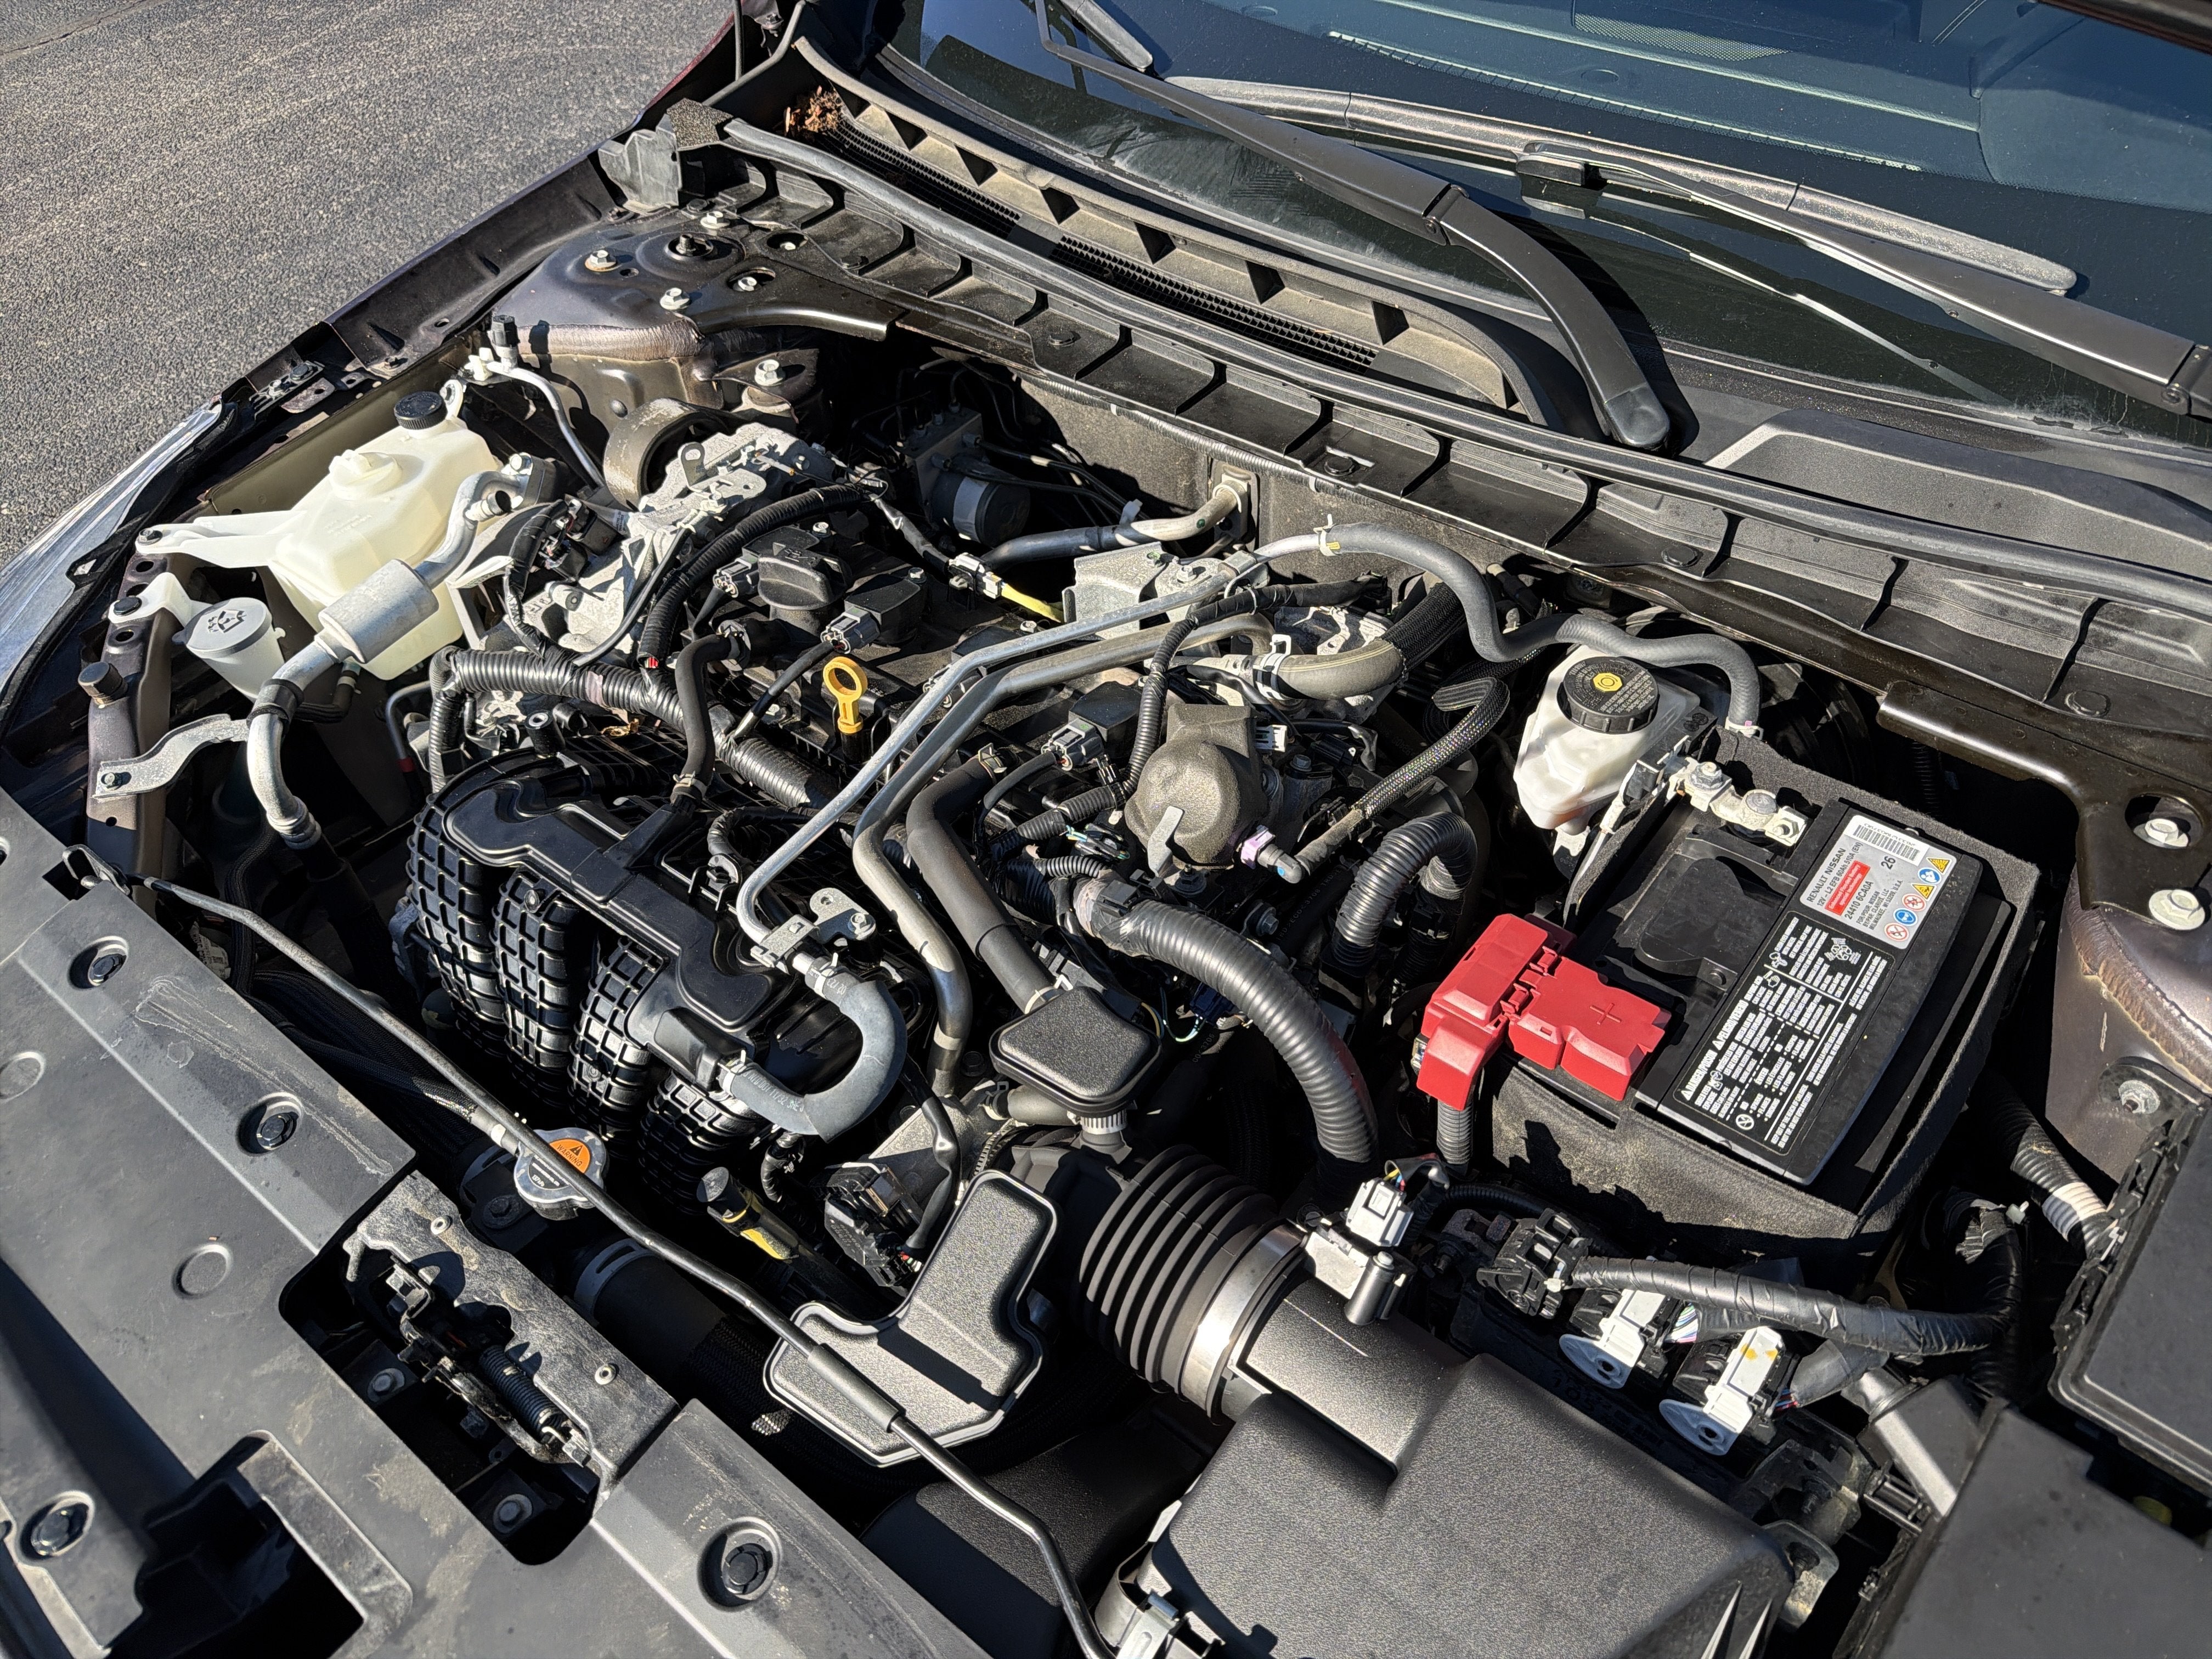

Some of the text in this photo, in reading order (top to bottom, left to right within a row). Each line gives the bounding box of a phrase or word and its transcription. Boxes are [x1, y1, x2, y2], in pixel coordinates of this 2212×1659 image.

[1807, 848, 1845, 902] RENAULT NISSAN
[1816, 897, 1826, 906] 12V
[1830, 876, 1839, 886] EFB
[1836, 863, 1848, 876] 60Ah
[1844, 852, 1855, 864] 510A
[1851, 842, 1863, 853] (EN)
[1880, 856, 1896, 869] 26
[1844, 880, 1873, 919] 24410 6CA0A
[1868, 891, 1880, 904] NISSAN
[556, 1144, 583, 1167] WARNING
